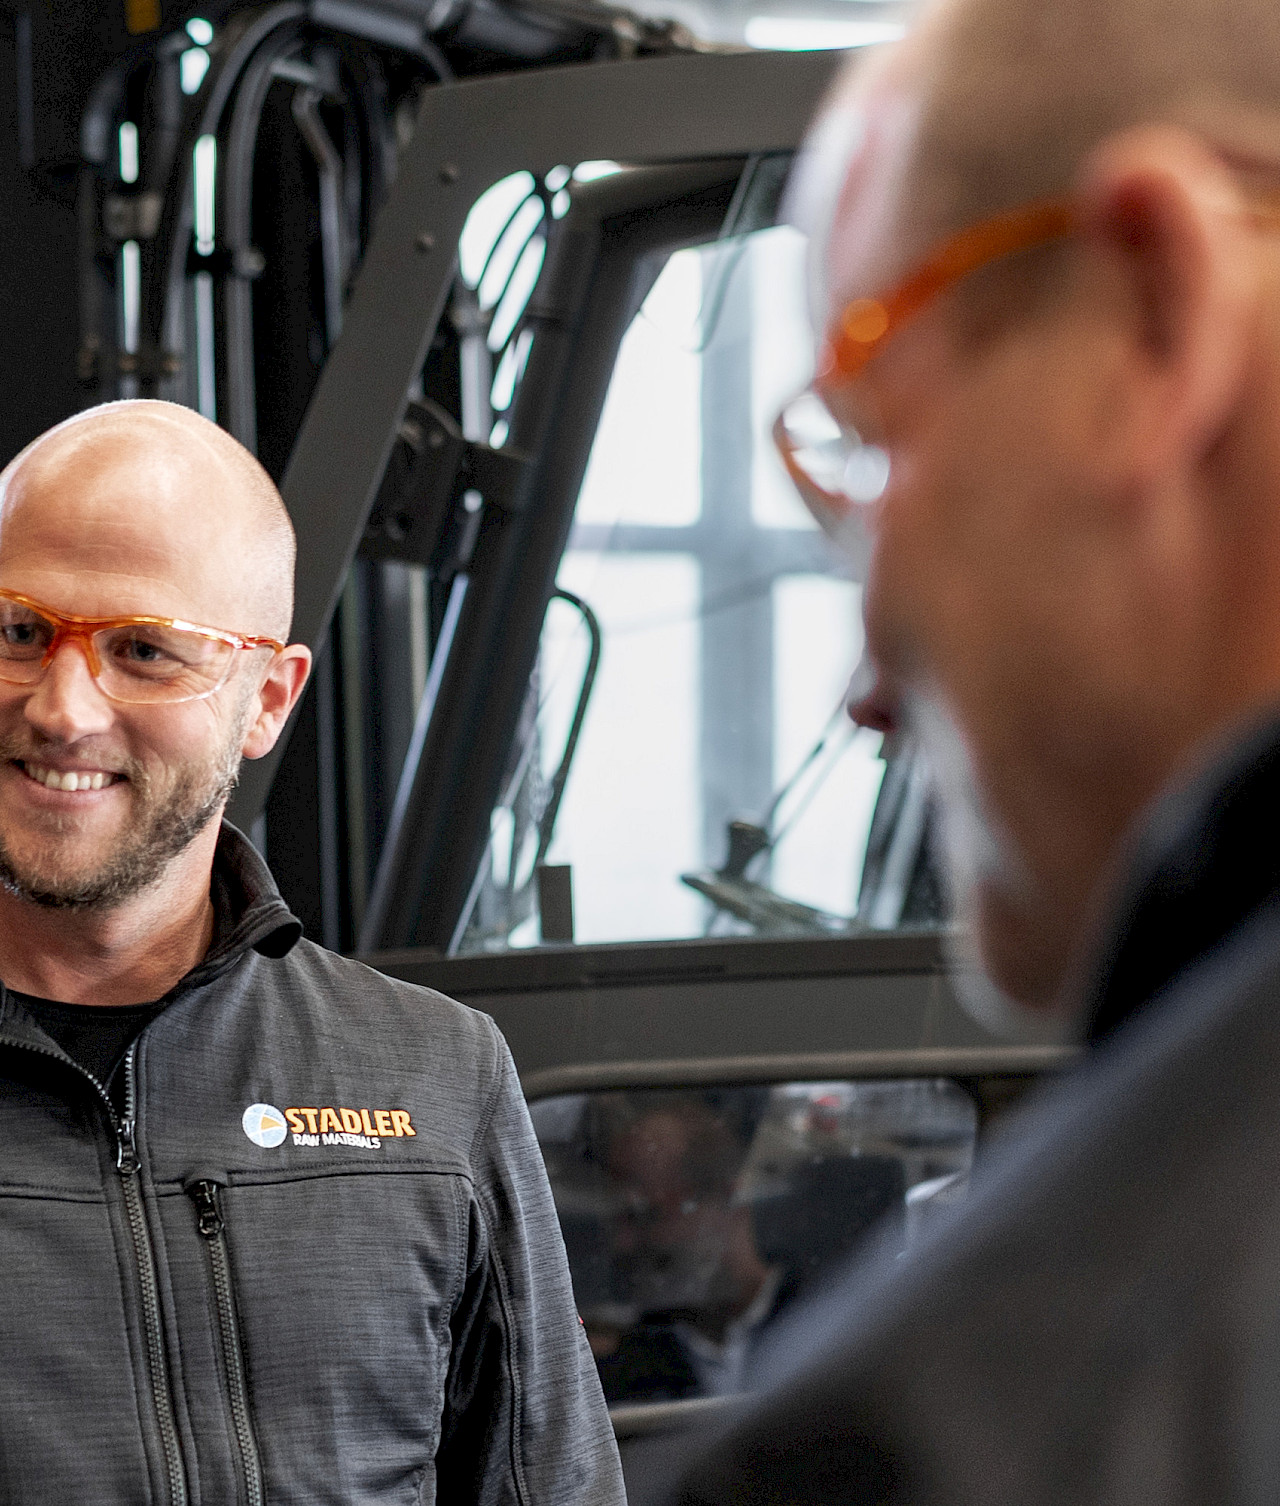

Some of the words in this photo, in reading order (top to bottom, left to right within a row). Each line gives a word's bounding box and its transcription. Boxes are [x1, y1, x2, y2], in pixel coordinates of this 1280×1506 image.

[284, 1107, 416, 1137] STADLER
[293, 1133, 320, 1147] RAW
[322, 1133, 381, 1149] MATERIALS
